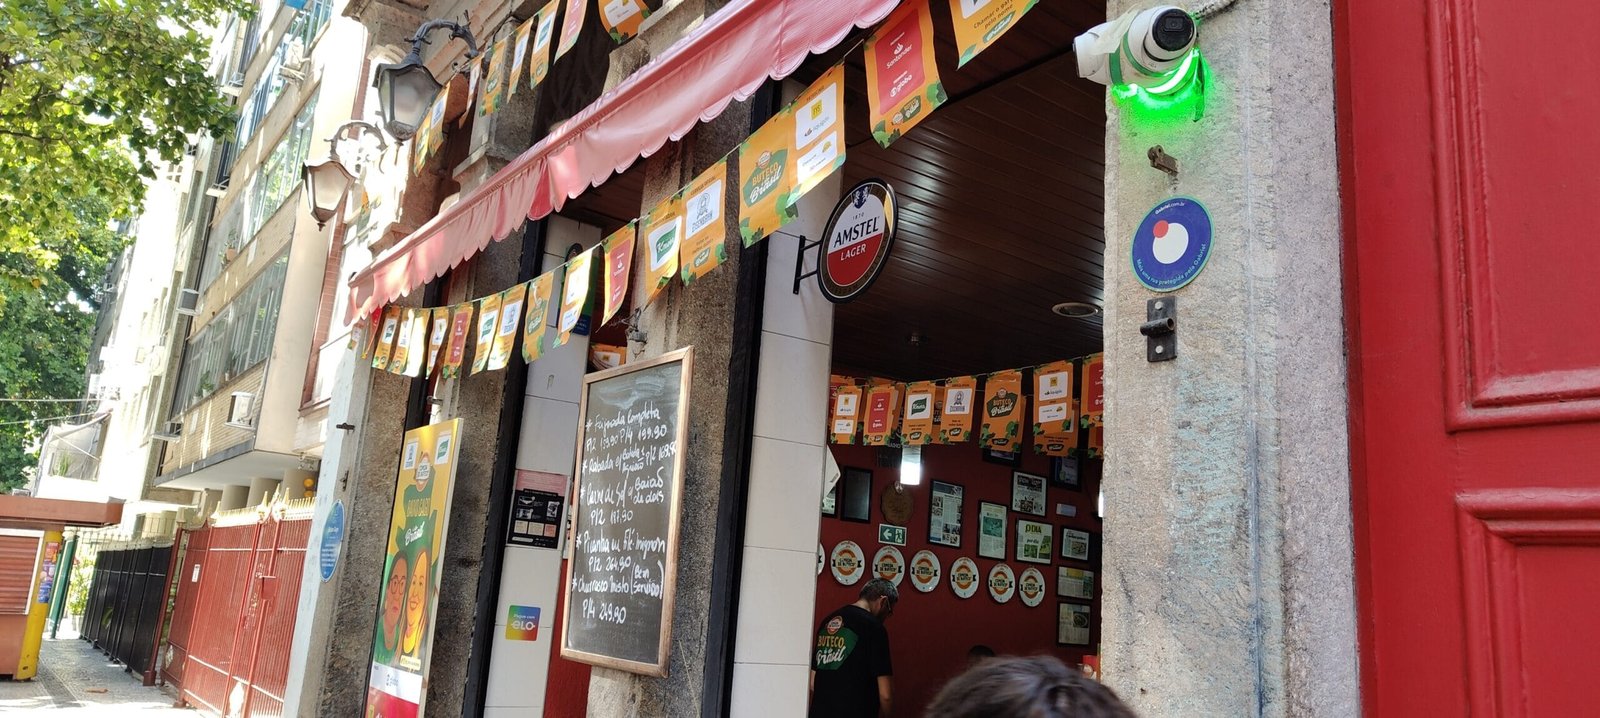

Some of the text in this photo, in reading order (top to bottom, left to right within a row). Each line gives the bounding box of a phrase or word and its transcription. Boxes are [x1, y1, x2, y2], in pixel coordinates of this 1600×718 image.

[886, 44, 912, 69] Santander
[897, 74, 913, 92] globo
[749, 165, 782, 203] Brasil
[752, 161, 779, 185] BUTECO
[834, 217, 878, 248] AMSTEL
[840, 243, 867, 261] LAGER
[1158, 274, 1185, 286] protegida
[1193, 243, 1207, 265] Gabriel
[1032, 524, 1042, 533] DIA
[817, 635, 845, 649] BUTECO
[816, 645, 847, 666] Brasil
